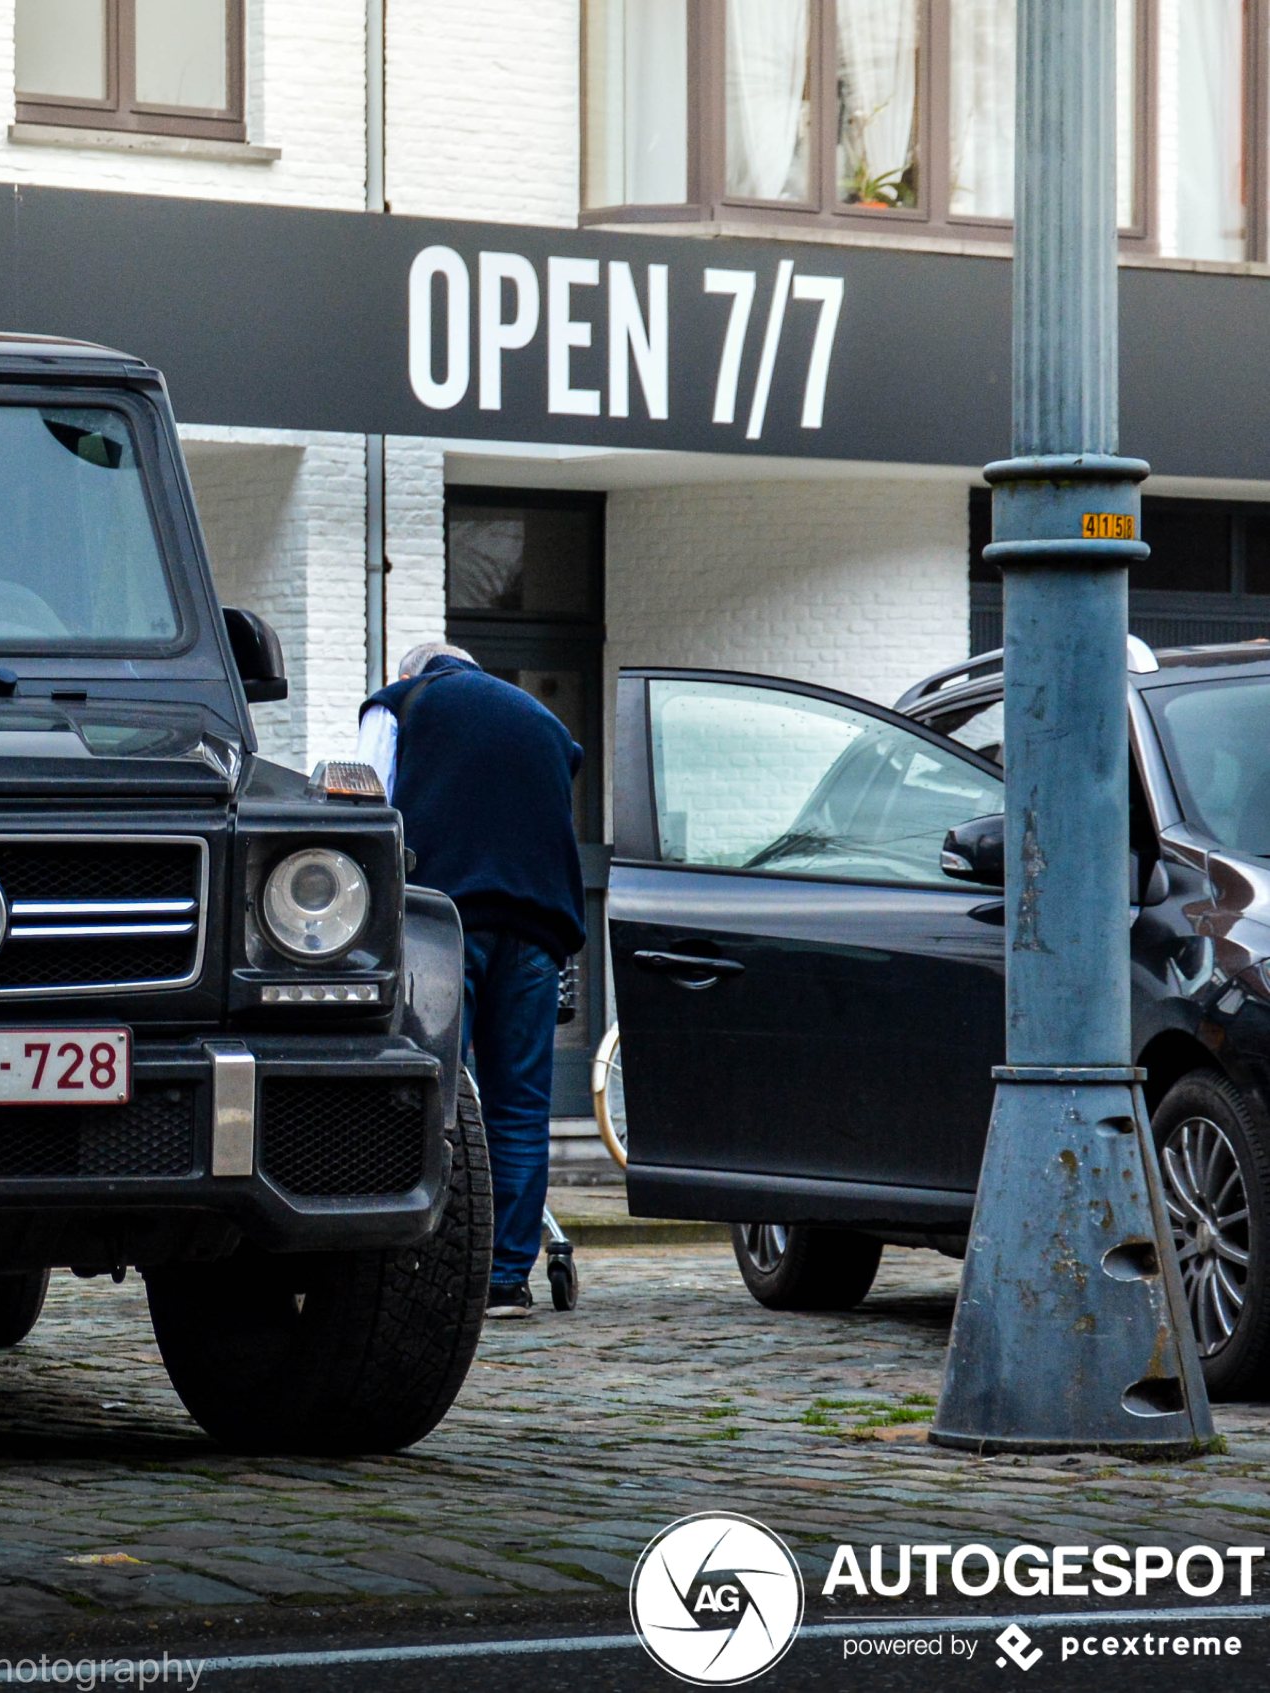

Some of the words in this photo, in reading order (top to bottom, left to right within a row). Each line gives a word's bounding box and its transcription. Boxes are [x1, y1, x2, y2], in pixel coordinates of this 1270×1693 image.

[408, 244, 669, 420] OPEN
[703, 259, 845, 440] 7/7
[1086, 515, 1133, 540] 4158
